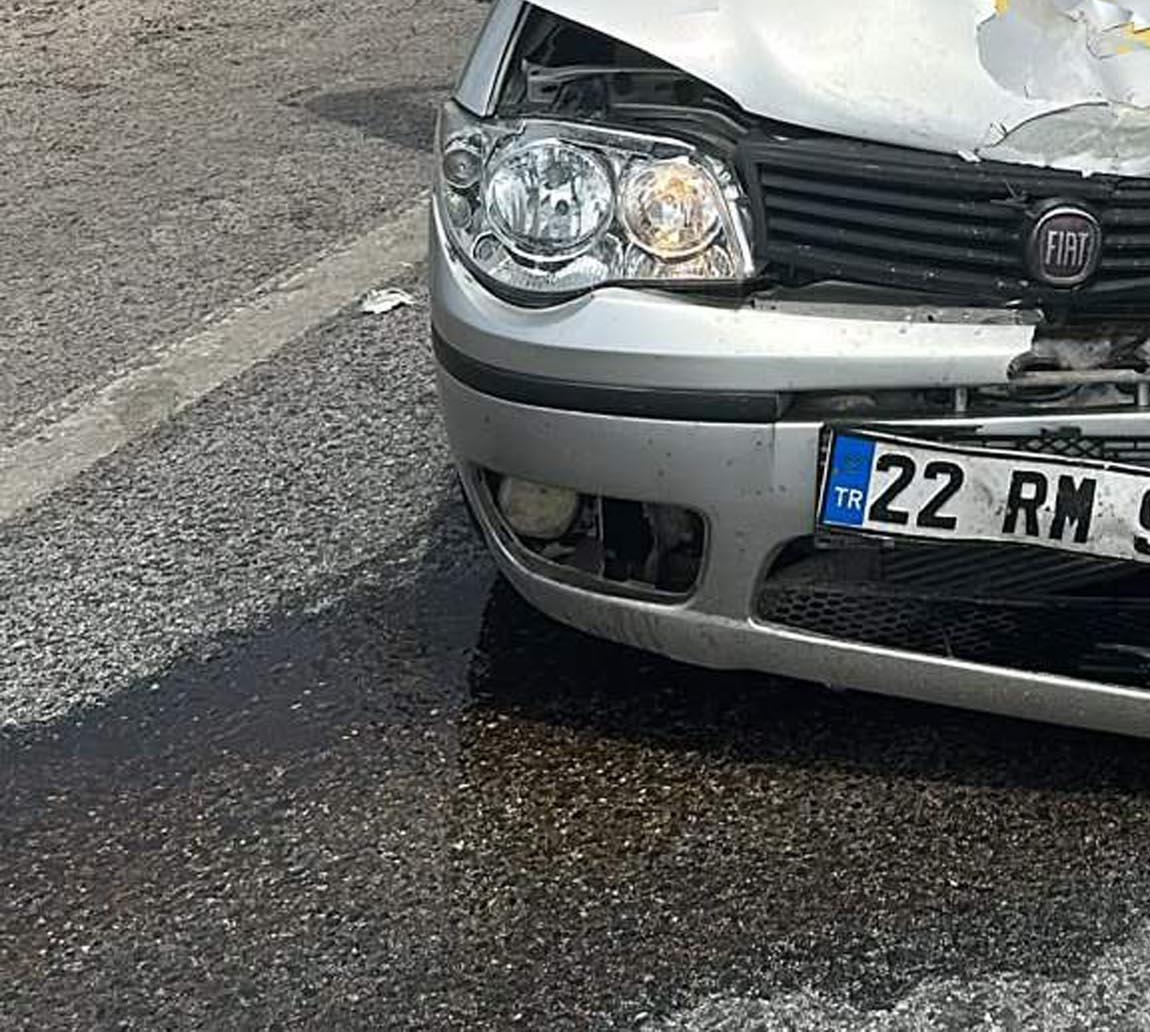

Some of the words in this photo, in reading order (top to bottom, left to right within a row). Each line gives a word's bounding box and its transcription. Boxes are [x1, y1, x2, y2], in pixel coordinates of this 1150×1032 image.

[1045, 229, 1089, 266] FIAT
[835, 486, 864, 510] TR
[867, 453, 965, 530] 22
[1002, 470, 1098, 544] RM
